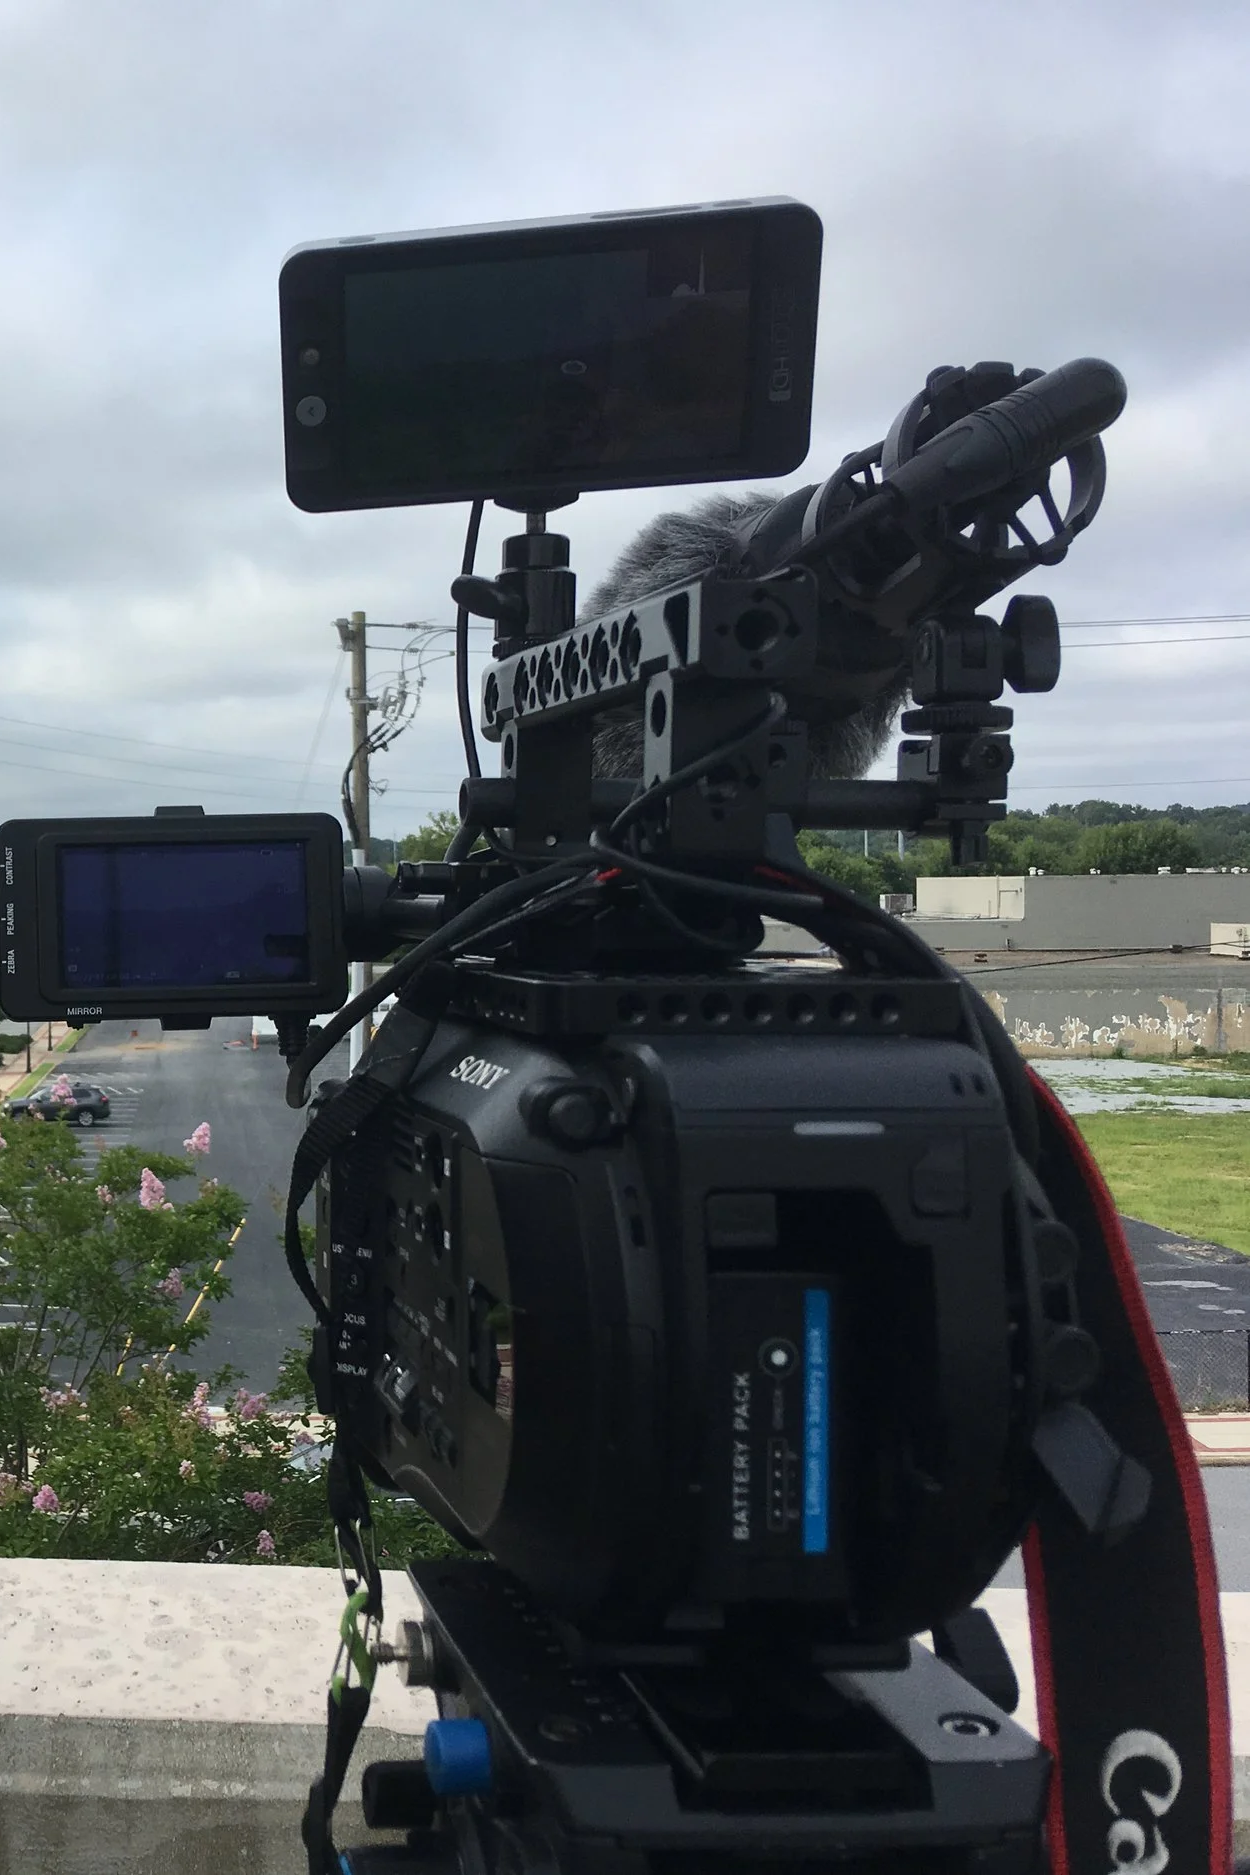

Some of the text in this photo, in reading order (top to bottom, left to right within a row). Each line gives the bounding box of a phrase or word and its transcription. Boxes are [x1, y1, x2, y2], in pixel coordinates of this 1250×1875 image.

[5, 846, 14, 886] CONTRAST
[6, 902, 15, 936] PEAKING
[7, 948, 16, 975] ZEBRA
[66, 1005, 103, 1017] MIRROR
[450, 1055, 510, 1090] SONY
[732, 1371, 750, 1541] BATTERY PACK
